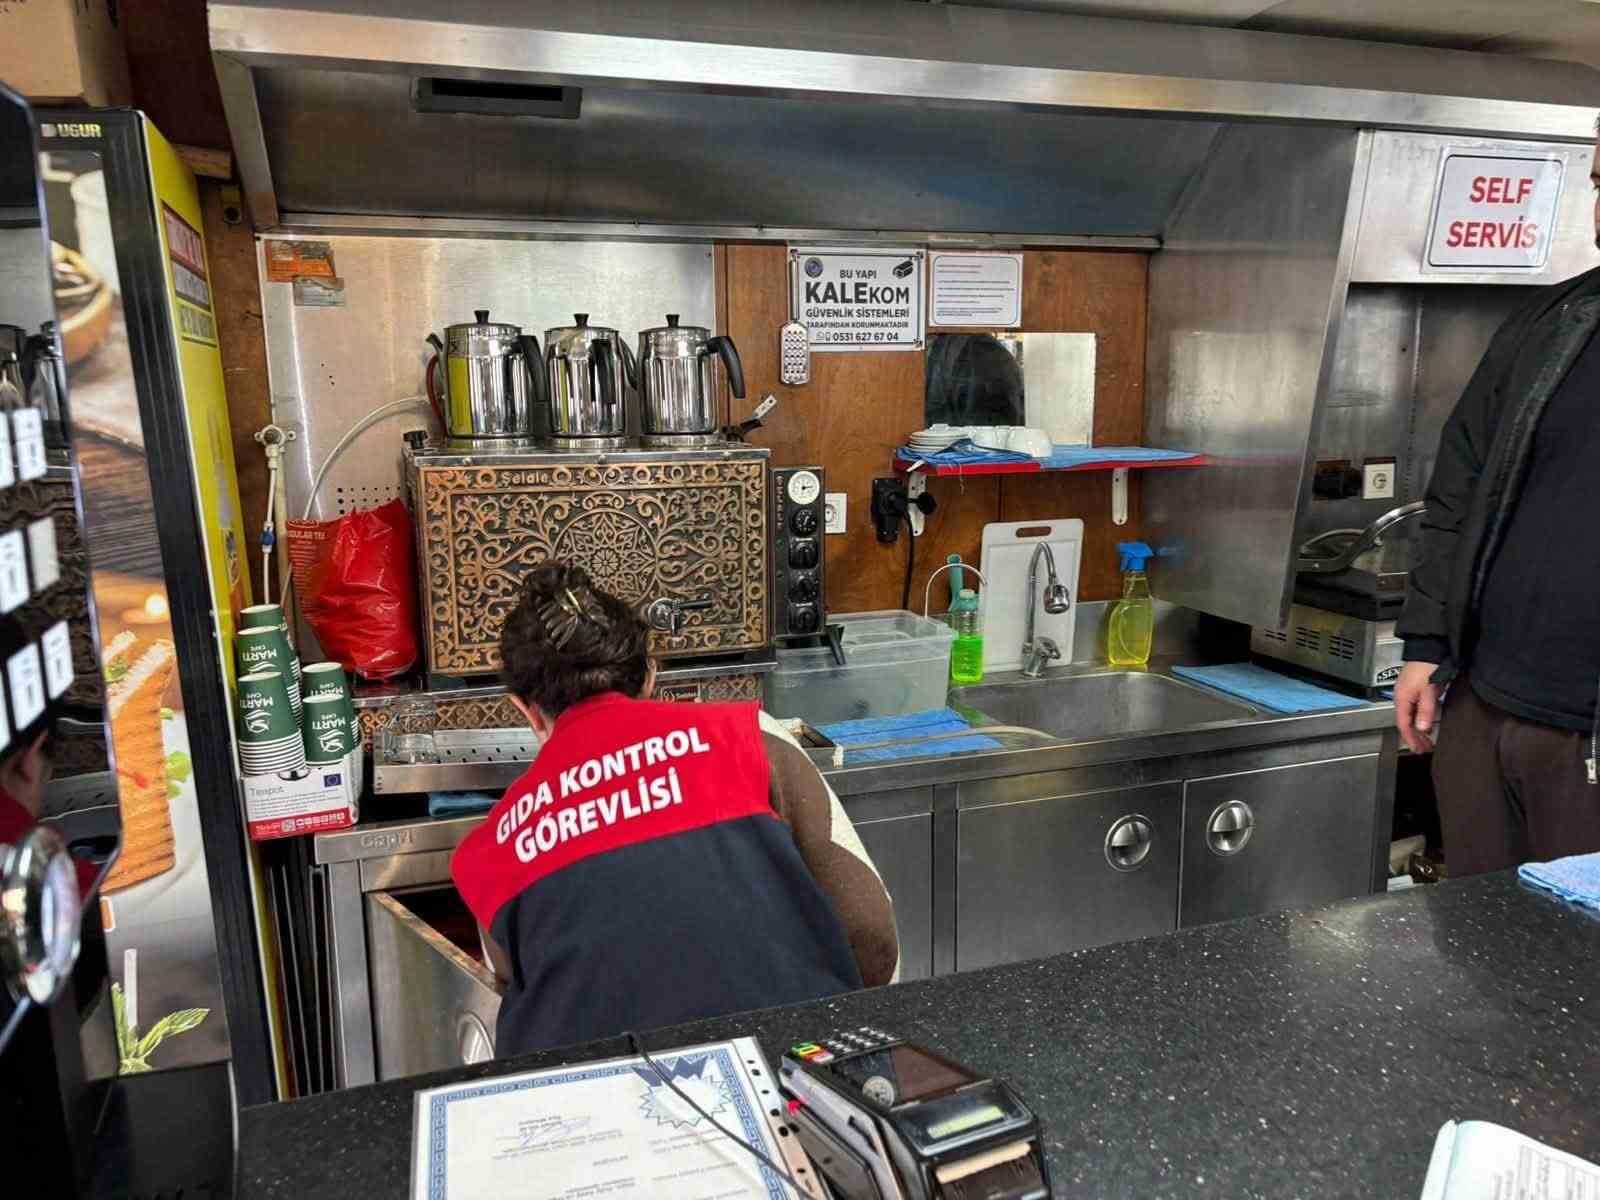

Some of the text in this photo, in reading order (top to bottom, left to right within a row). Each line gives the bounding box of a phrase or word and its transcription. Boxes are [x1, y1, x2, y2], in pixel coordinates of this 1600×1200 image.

[1469, 176, 1533, 204] SELF
[1446, 216, 1537, 248] SERVİS
[840, 270, 876, 279] BU YAPI
[806, 306, 909, 318] GÜVENLİK SİSTEMLERİ
[807, 321, 909, 329] TARAFINDAN KORUNMAKTADIR
[833, 332, 899, 341] 0531 627 67 04
[242, 648, 277, 661] MARTI
[312, 716, 346, 729] MARTI
[496, 727, 710, 844] GIDA KONTROL
[514, 766, 683, 863] GÖREVLİSİ
